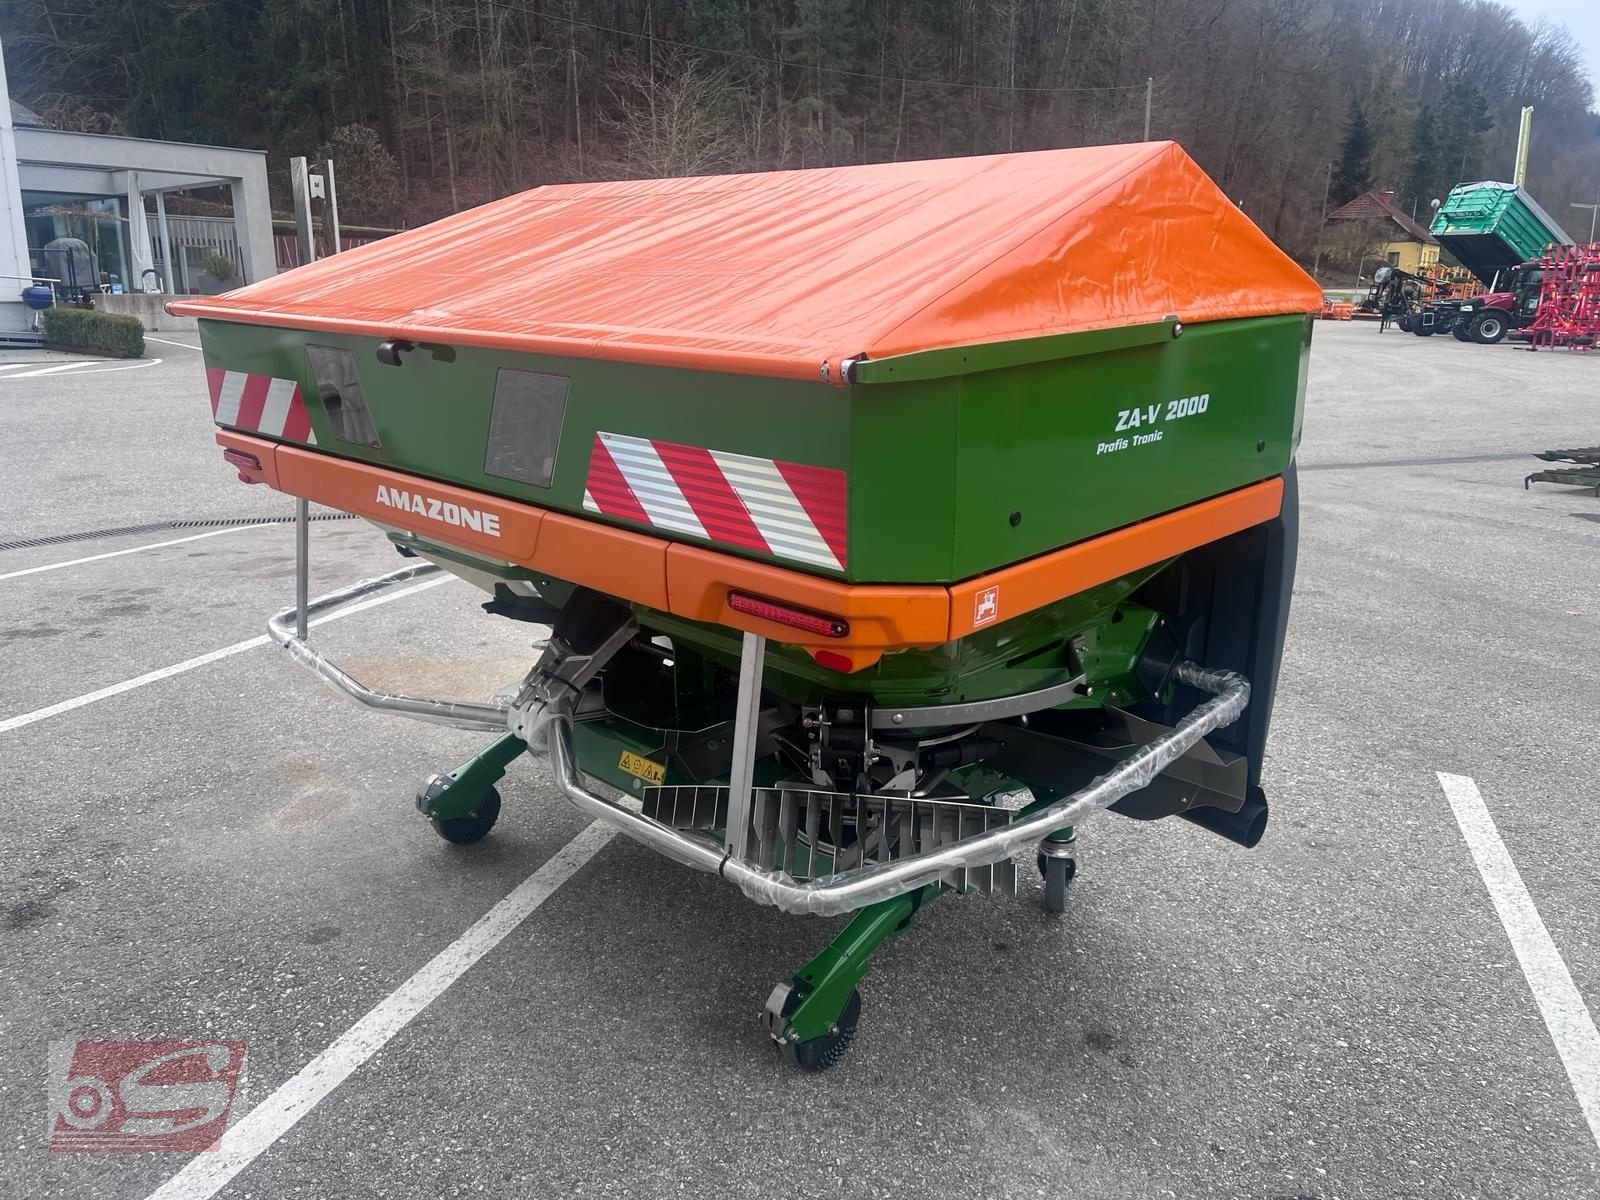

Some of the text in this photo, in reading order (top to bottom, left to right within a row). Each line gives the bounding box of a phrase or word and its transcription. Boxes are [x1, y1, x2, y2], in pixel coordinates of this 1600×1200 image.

[1115, 393, 1210, 432] ZA-V 2000
[1096, 429, 1164, 455] Profis Tronic
[376, 485, 500, 537] AMAZONE
